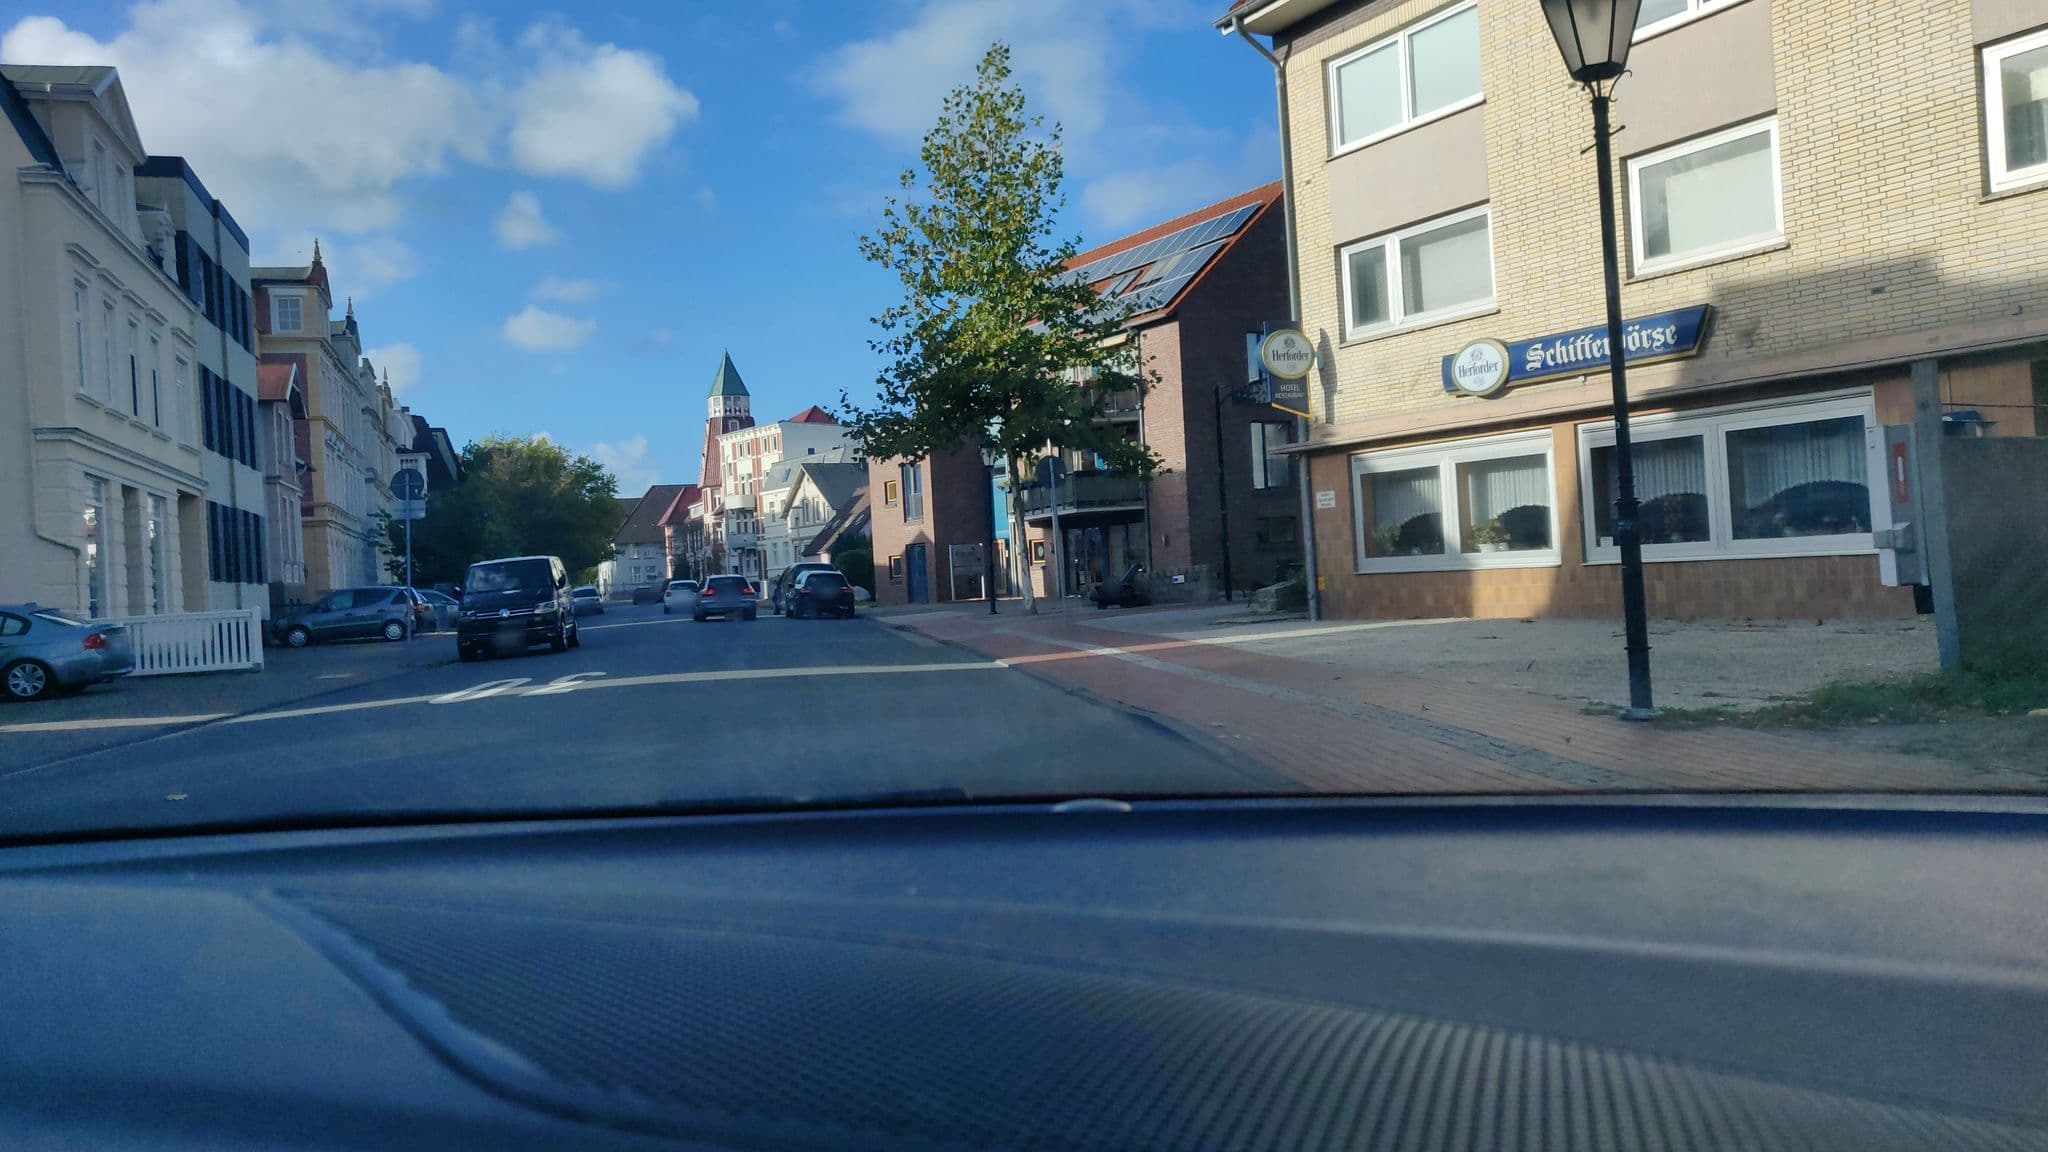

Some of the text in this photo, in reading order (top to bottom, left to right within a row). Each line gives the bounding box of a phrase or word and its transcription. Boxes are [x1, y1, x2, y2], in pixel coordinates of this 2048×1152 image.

[1272, 349, 1309, 361] Herforder
[1526, 324, 1677, 371] Schifferörse
[1458, 360, 1498, 378] Herforder
[1280, 384, 1300, 392] HOTEL
